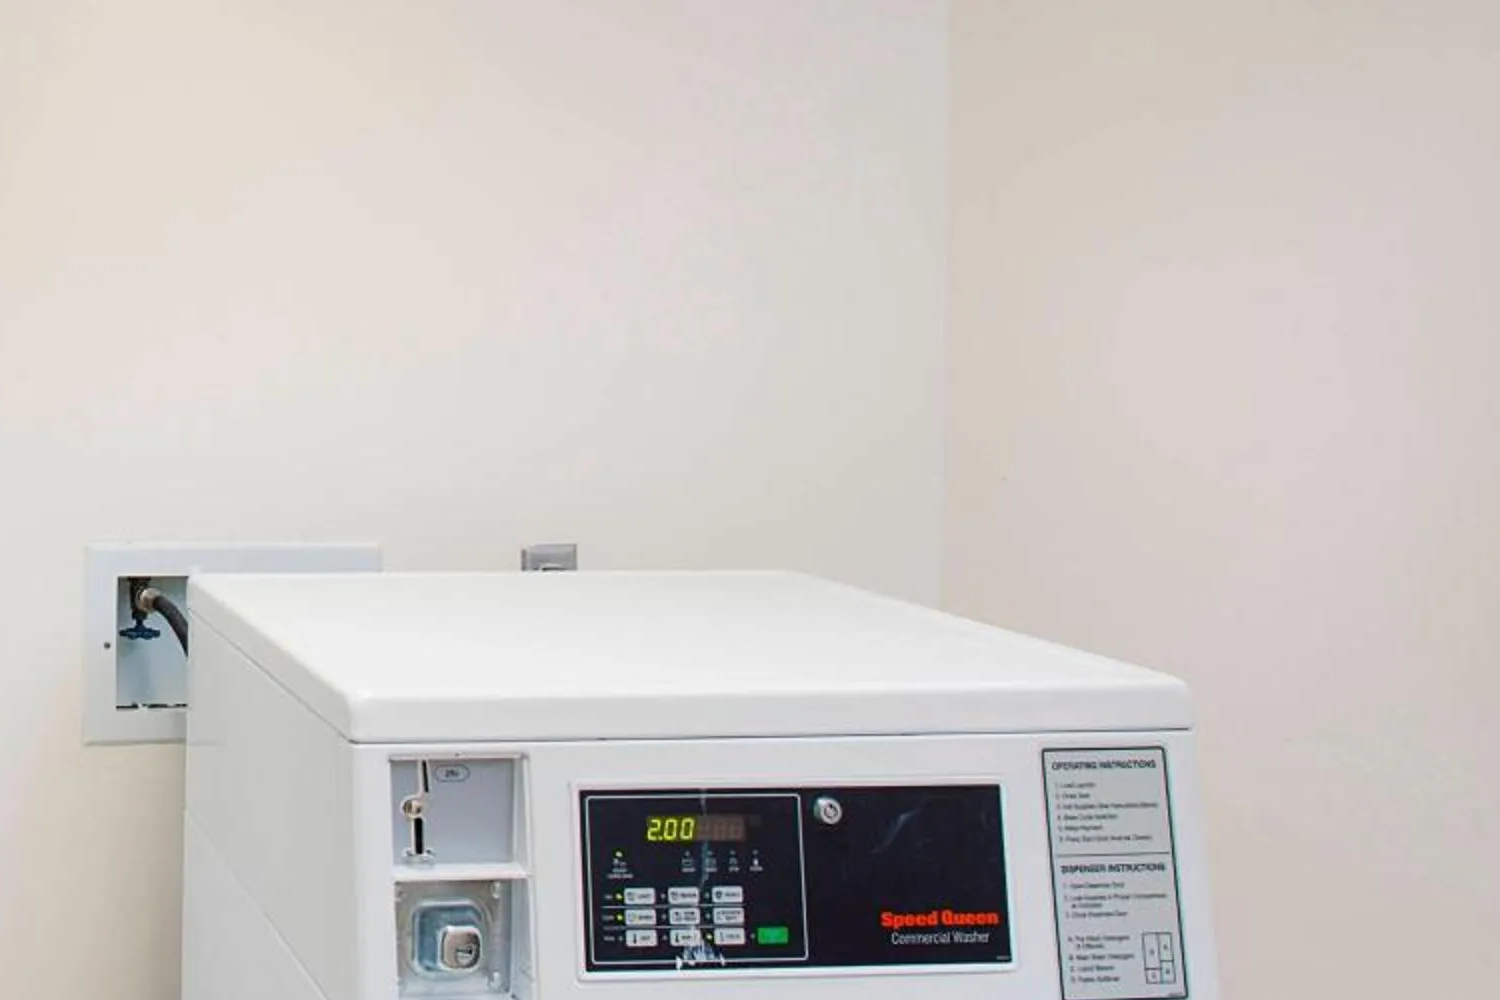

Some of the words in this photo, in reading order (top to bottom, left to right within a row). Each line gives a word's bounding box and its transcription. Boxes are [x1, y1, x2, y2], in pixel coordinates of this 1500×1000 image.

[647, 817, 695, 841] 2.00
[880, 911, 938, 929] Speed
[942, 909, 999, 926] Queen
[891, 932, 951, 944] Commercial
[952, 931, 990, 944] Washer
